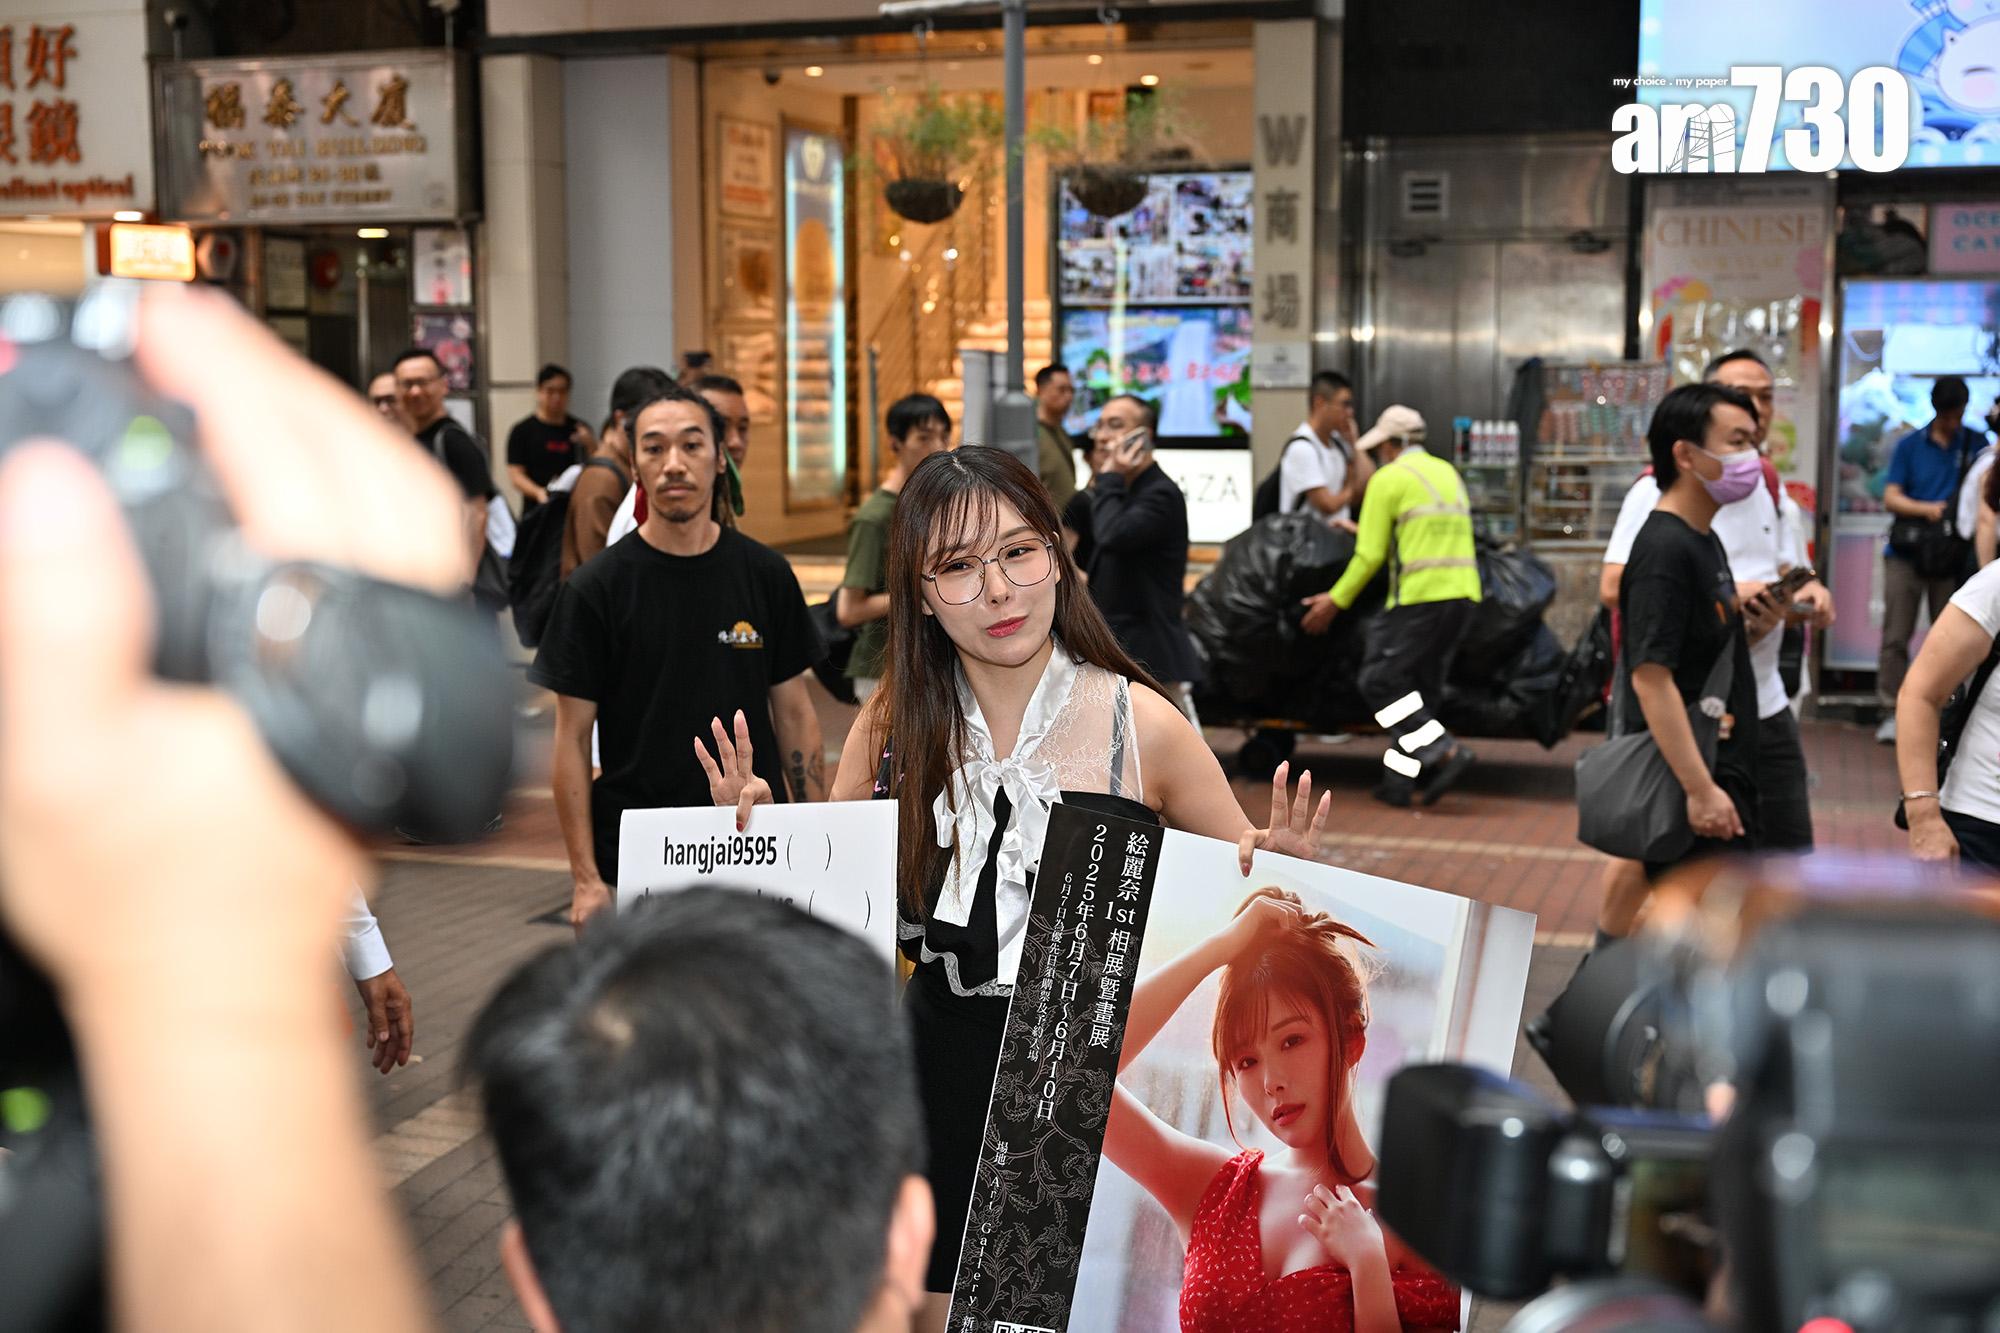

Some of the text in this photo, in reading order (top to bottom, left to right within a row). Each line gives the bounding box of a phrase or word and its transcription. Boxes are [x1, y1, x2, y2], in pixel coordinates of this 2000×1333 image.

[0, 25, 77, 90] 好
[664, 835, 778, 874] hangjai9595
[967, 1222, 992, 1307] Gallery
